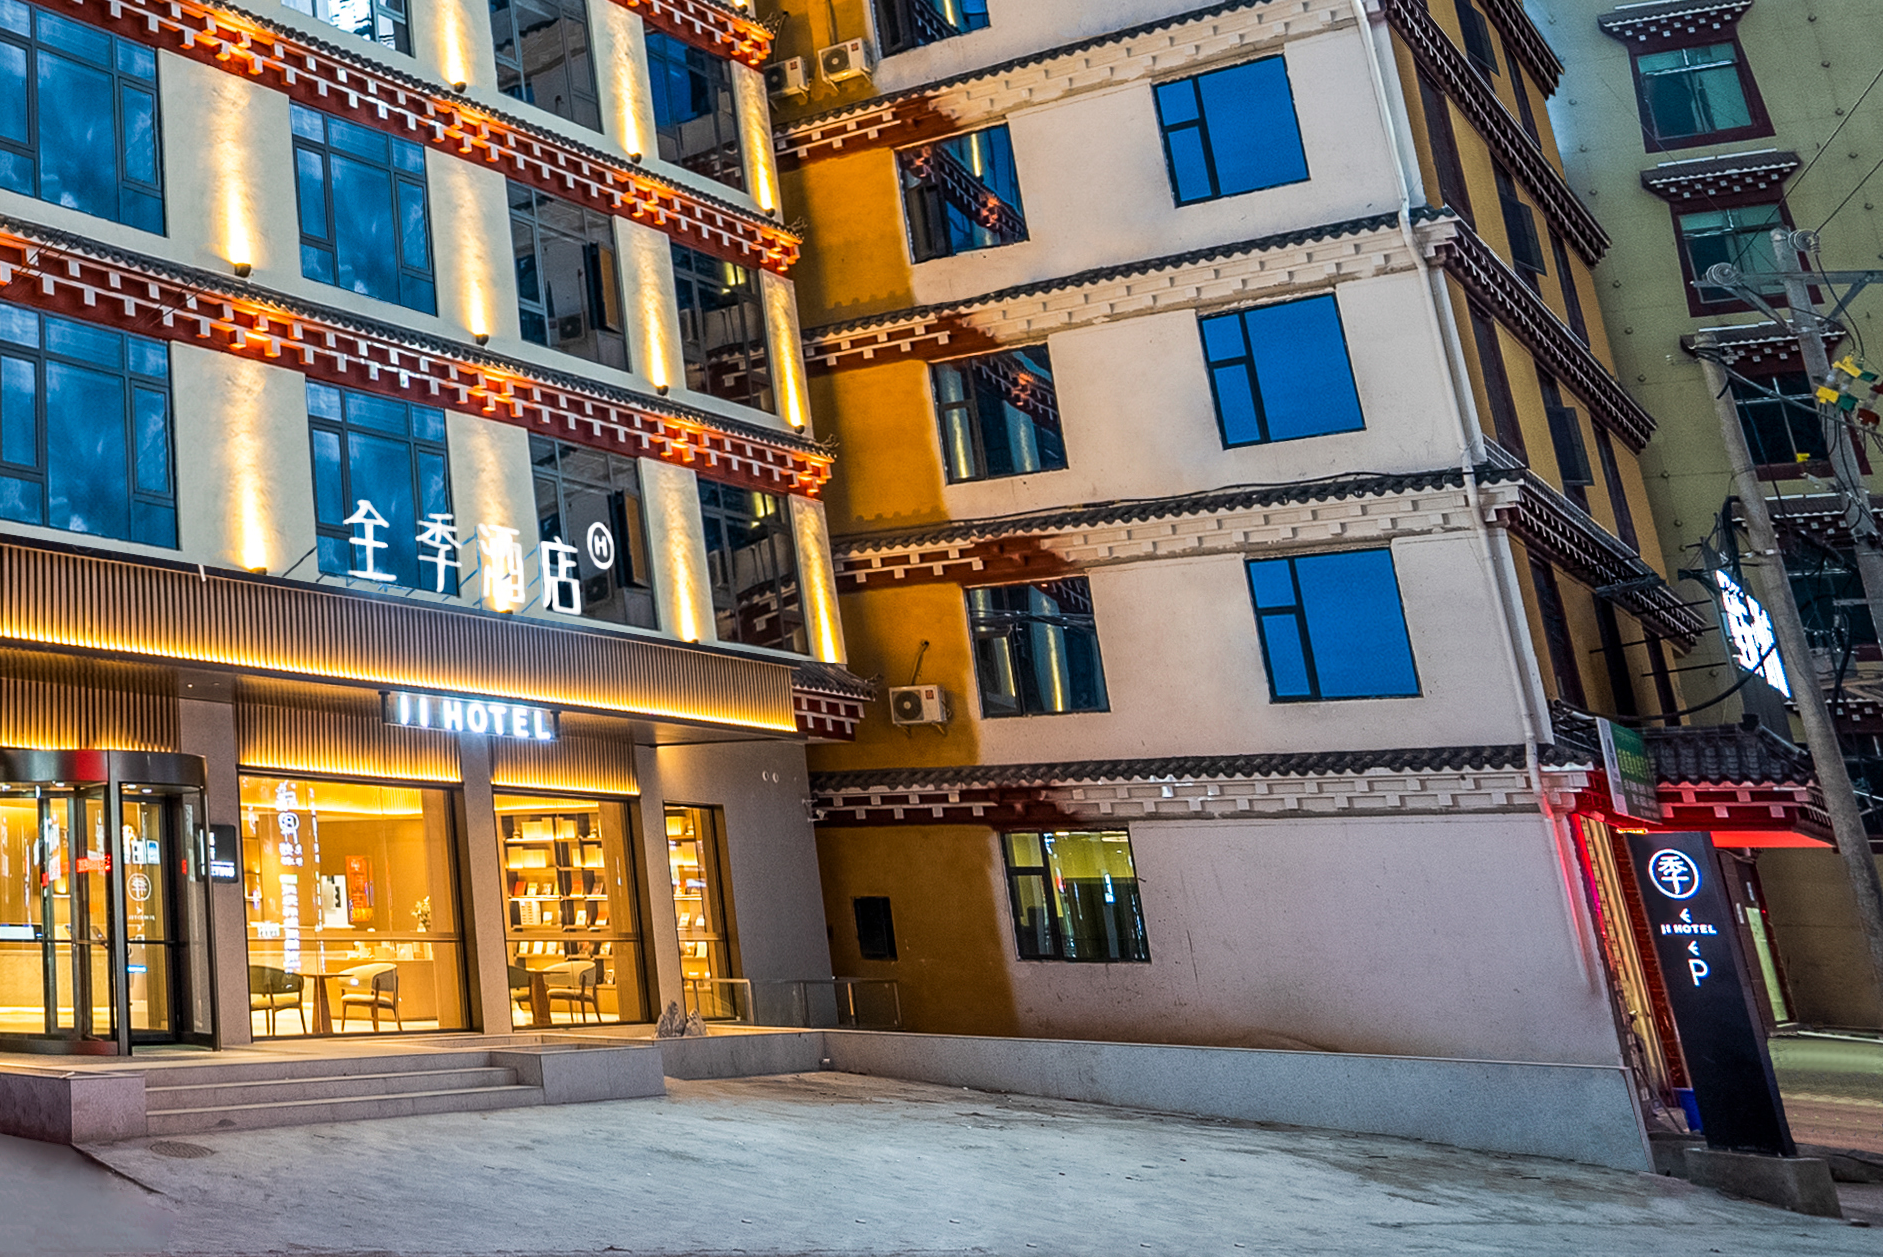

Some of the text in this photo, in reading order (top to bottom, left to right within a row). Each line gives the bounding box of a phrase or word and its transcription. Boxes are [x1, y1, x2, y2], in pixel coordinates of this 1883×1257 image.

[343, 499, 581, 615] 全季酒店
[443, 700, 552, 741] HOTEL
[1672, 924, 1717, 934] HOTEL
[1688, 959, 1709, 987] P
